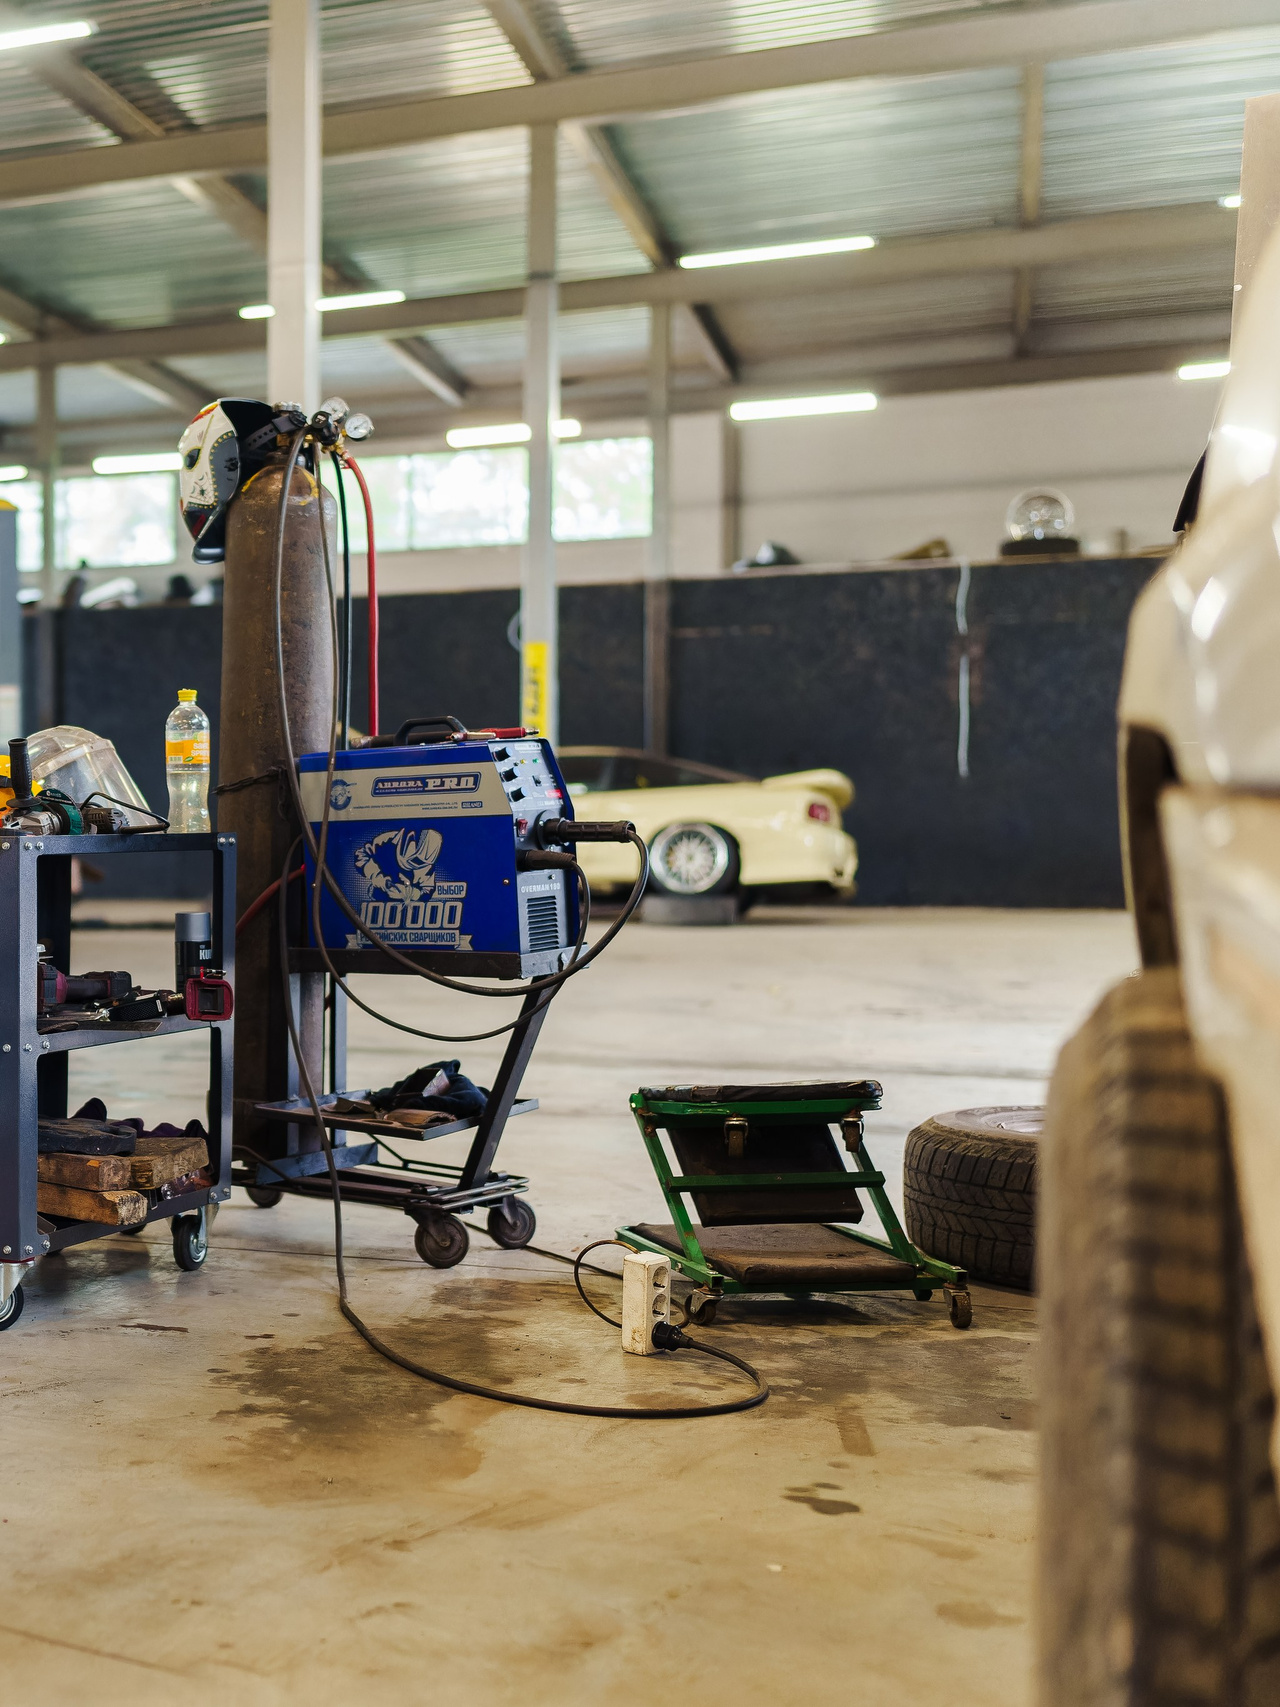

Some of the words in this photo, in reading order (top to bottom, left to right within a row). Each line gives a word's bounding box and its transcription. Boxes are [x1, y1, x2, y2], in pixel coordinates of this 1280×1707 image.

[375, 780, 424, 790] AURORA
[425, 776, 476, 791] PRO
[437, 885, 464, 896] ВЫБОР
[521, 884, 549, 893] OVERMAN
[409, 932, 456, 944] СВАРЩИКОВ
